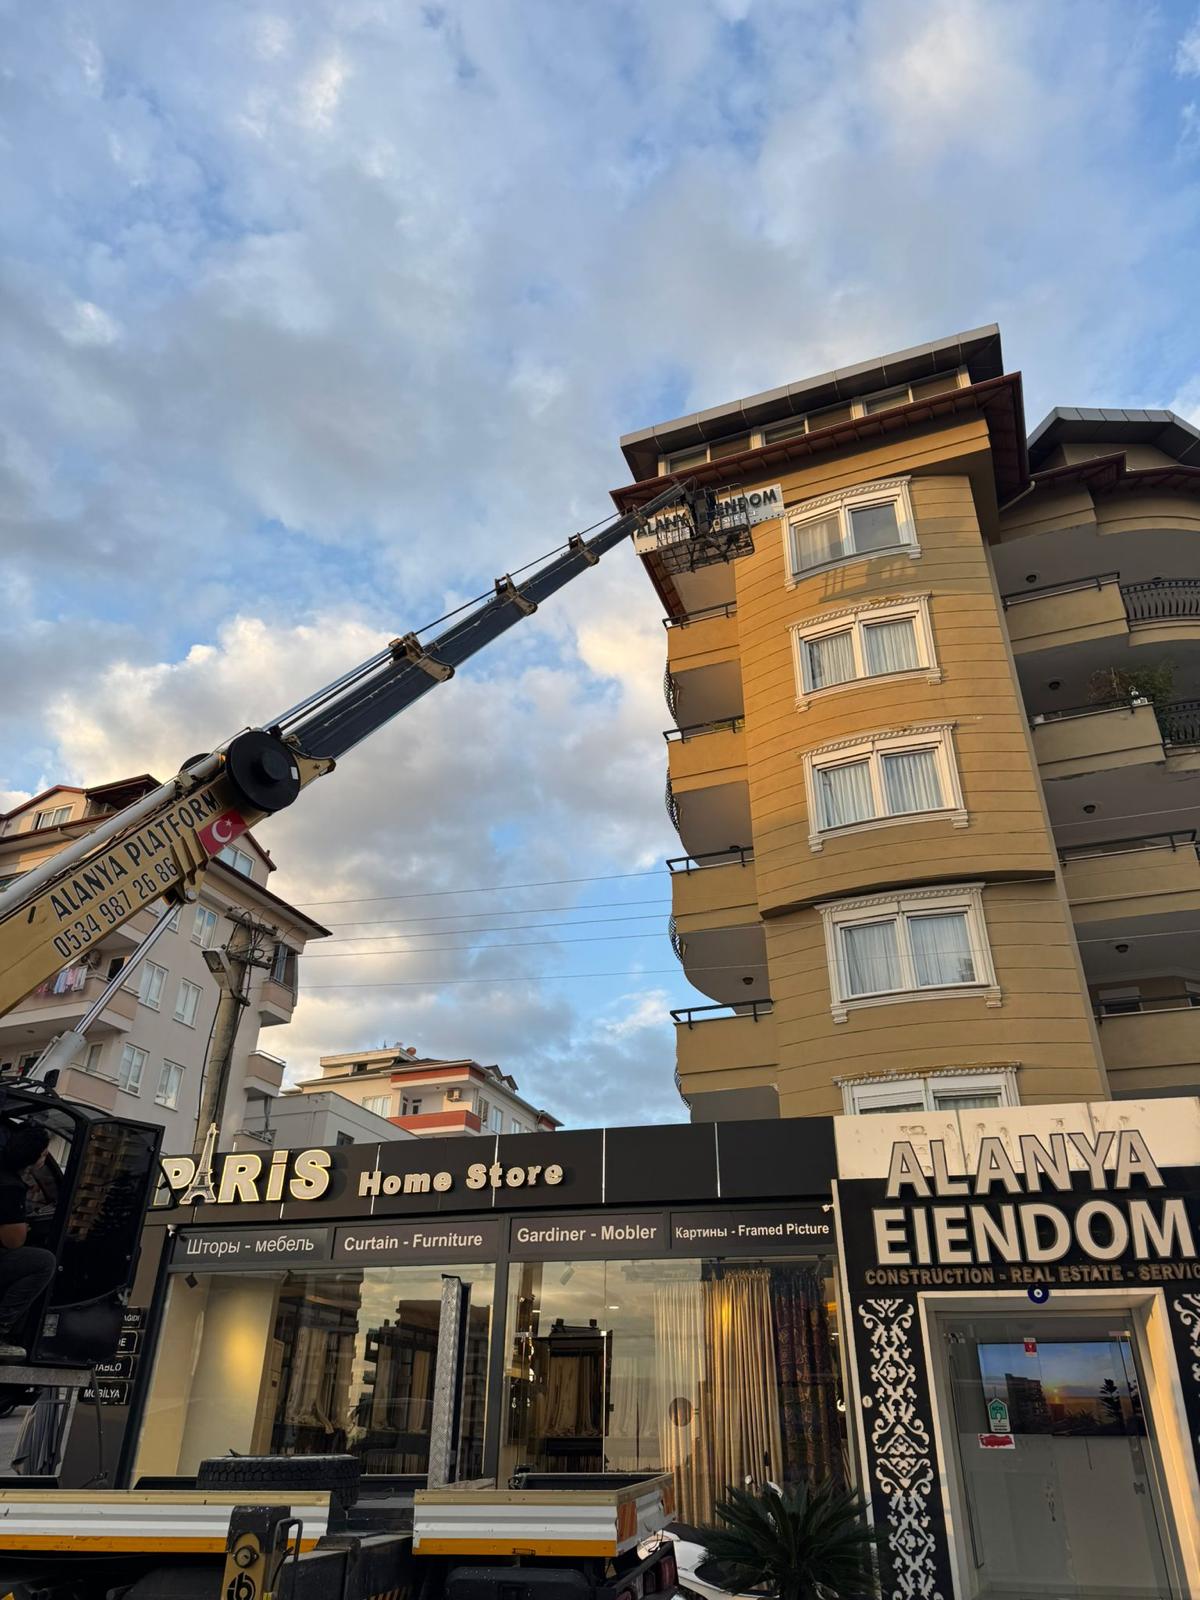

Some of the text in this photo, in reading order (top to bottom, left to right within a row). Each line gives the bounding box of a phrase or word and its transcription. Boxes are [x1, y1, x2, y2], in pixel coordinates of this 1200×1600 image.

[50, 855, 129, 921] ALANYA
[53, 857, 178, 958] 0534 987 26 86
[886, 1129, 1167, 1198] ALANYA
[358, 1170, 453, 1197] Home
[465, 1162, 564, 1190] Store
[344, 1236, 399, 1251] Curtain
[412, 1233, 483, 1248] Furniture
[517, 1227, 586, 1243] Gardiner
[601, 1225, 657, 1241] Mobler
[675, 1226, 728, 1241] Картины
[738, 1222, 783, 1237] Framed
[786, 1222, 830, 1236] Picture
[872, 1198, 1198, 1265] EIENDOM
[186, 1238, 241, 1257] Шторы
[255, 1235, 315, 1253] мебель
[865, 1267, 995, 1286] CONSTRUCTION
[1010, 1265, 1056, 1283] REAL
[1058, 1264, 1124, 1282] ESTATE
